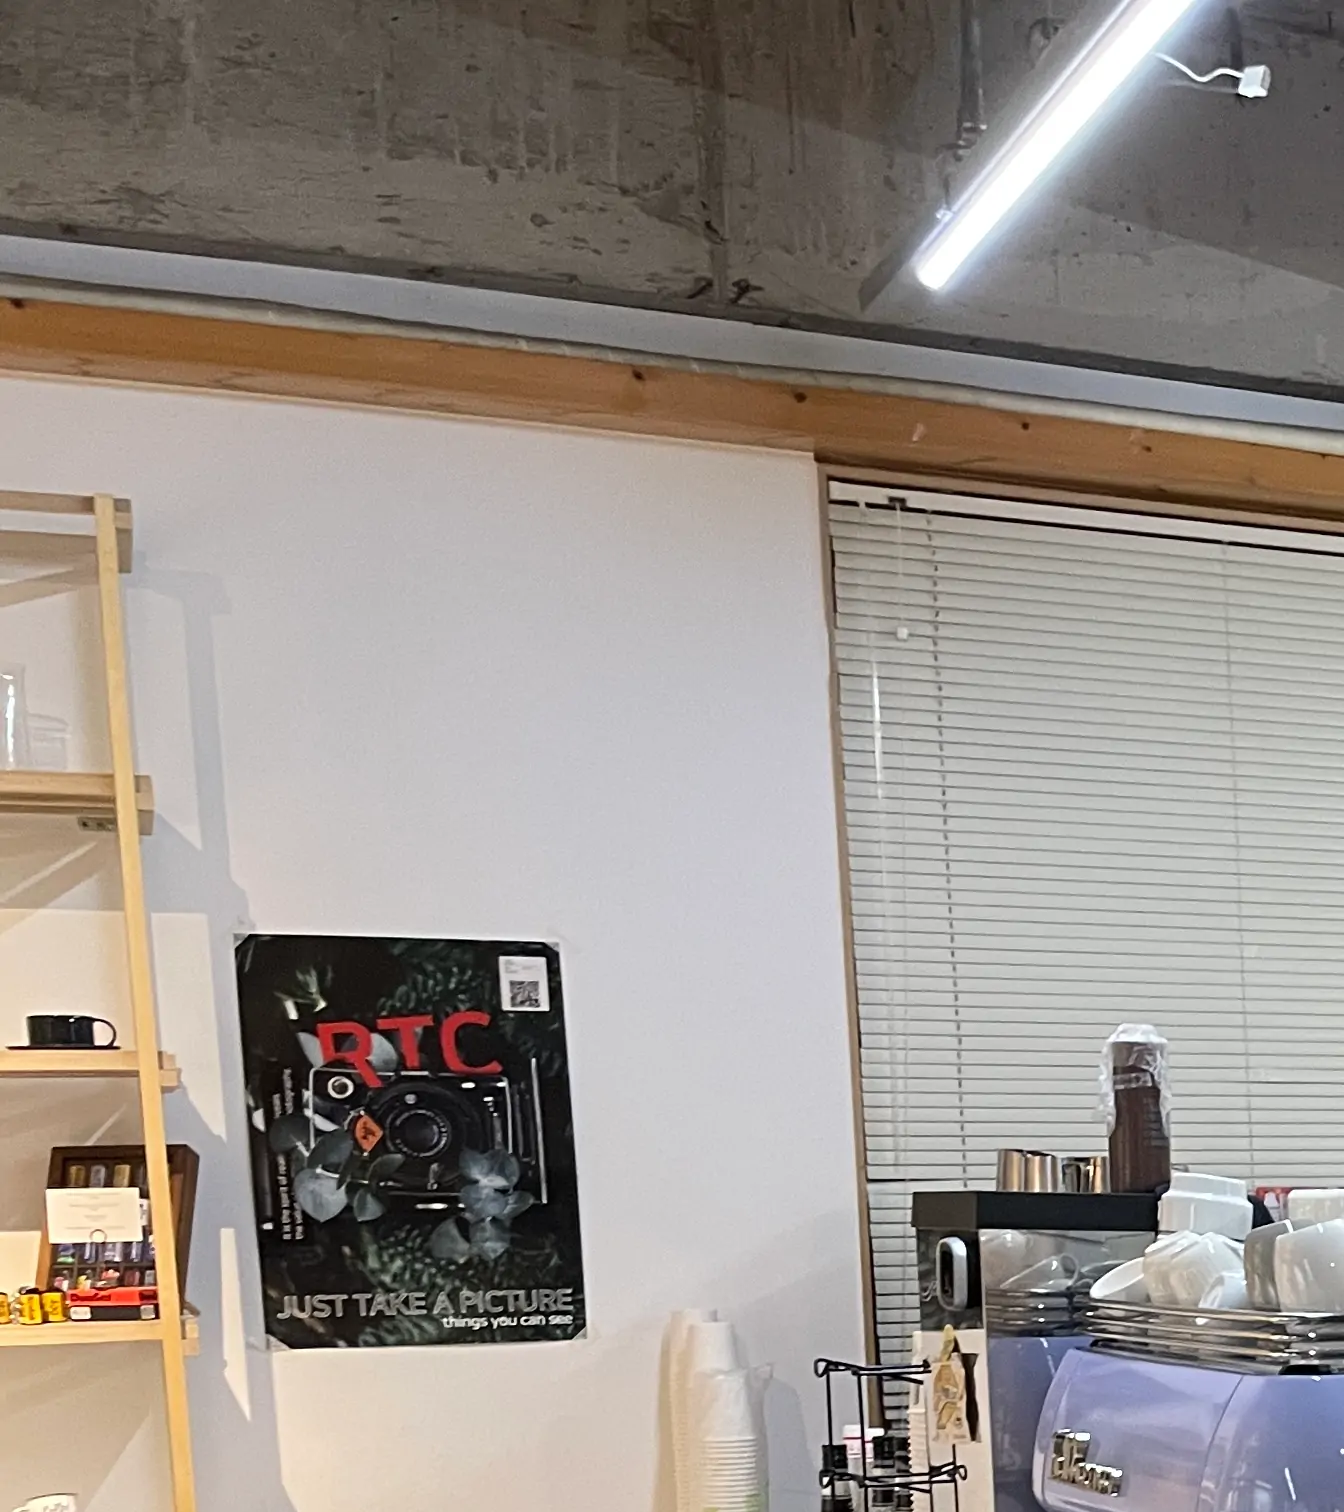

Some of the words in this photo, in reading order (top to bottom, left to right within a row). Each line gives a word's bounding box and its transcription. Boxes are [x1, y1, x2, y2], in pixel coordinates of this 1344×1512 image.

[316, 1010, 503, 1088] RTC
[276, 1294, 348, 1319] JUST
[352, 1292, 427, 1317] TAKE
[432, 1292, 454, 1314] A
[460, 1288, 573, 1314] PICTURE
[442, 1314, 489, 1331] things
[491, 1315, 518, 1329] you
[520, 1315, 546, 1326] can
[548, 1314, 574, 1325] see
